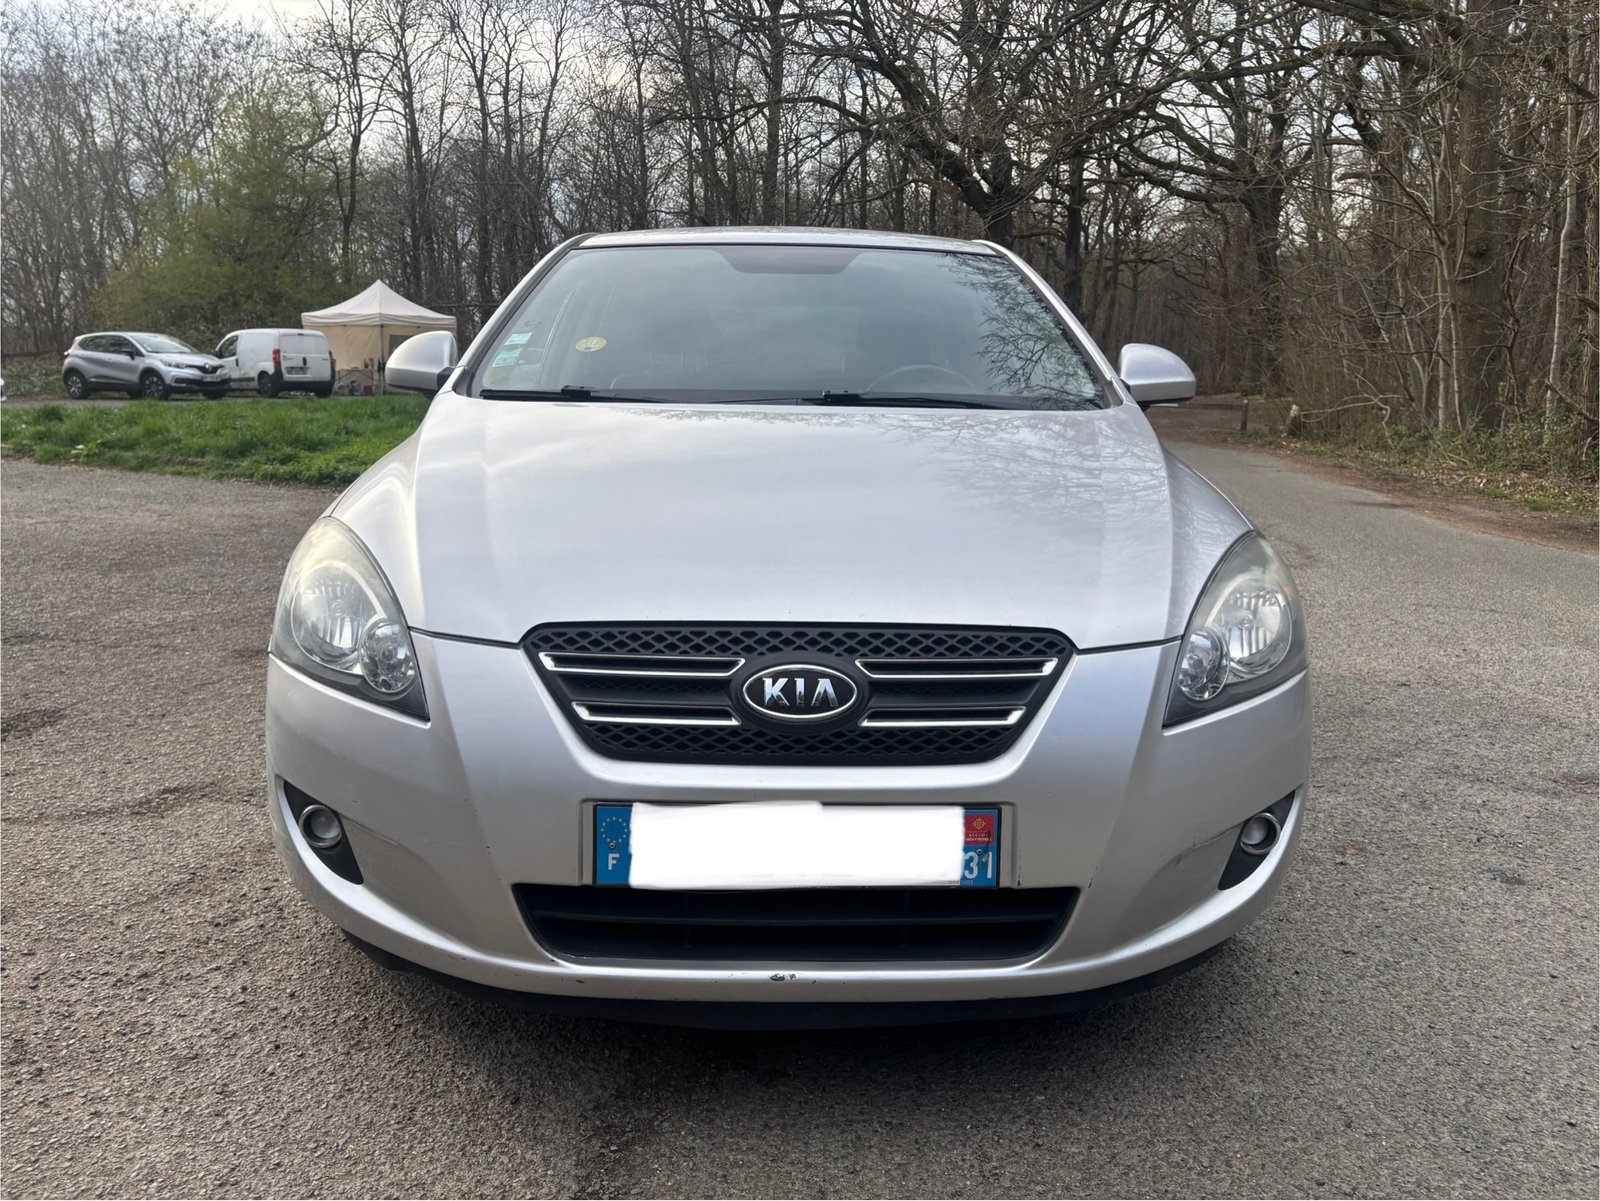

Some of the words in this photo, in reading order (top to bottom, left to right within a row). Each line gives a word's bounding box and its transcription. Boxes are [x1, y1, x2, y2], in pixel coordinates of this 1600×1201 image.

[762, 677, 839, 707] KIA
[608, 853, 620, 870] F
[964, 851, 992, 879] 31
